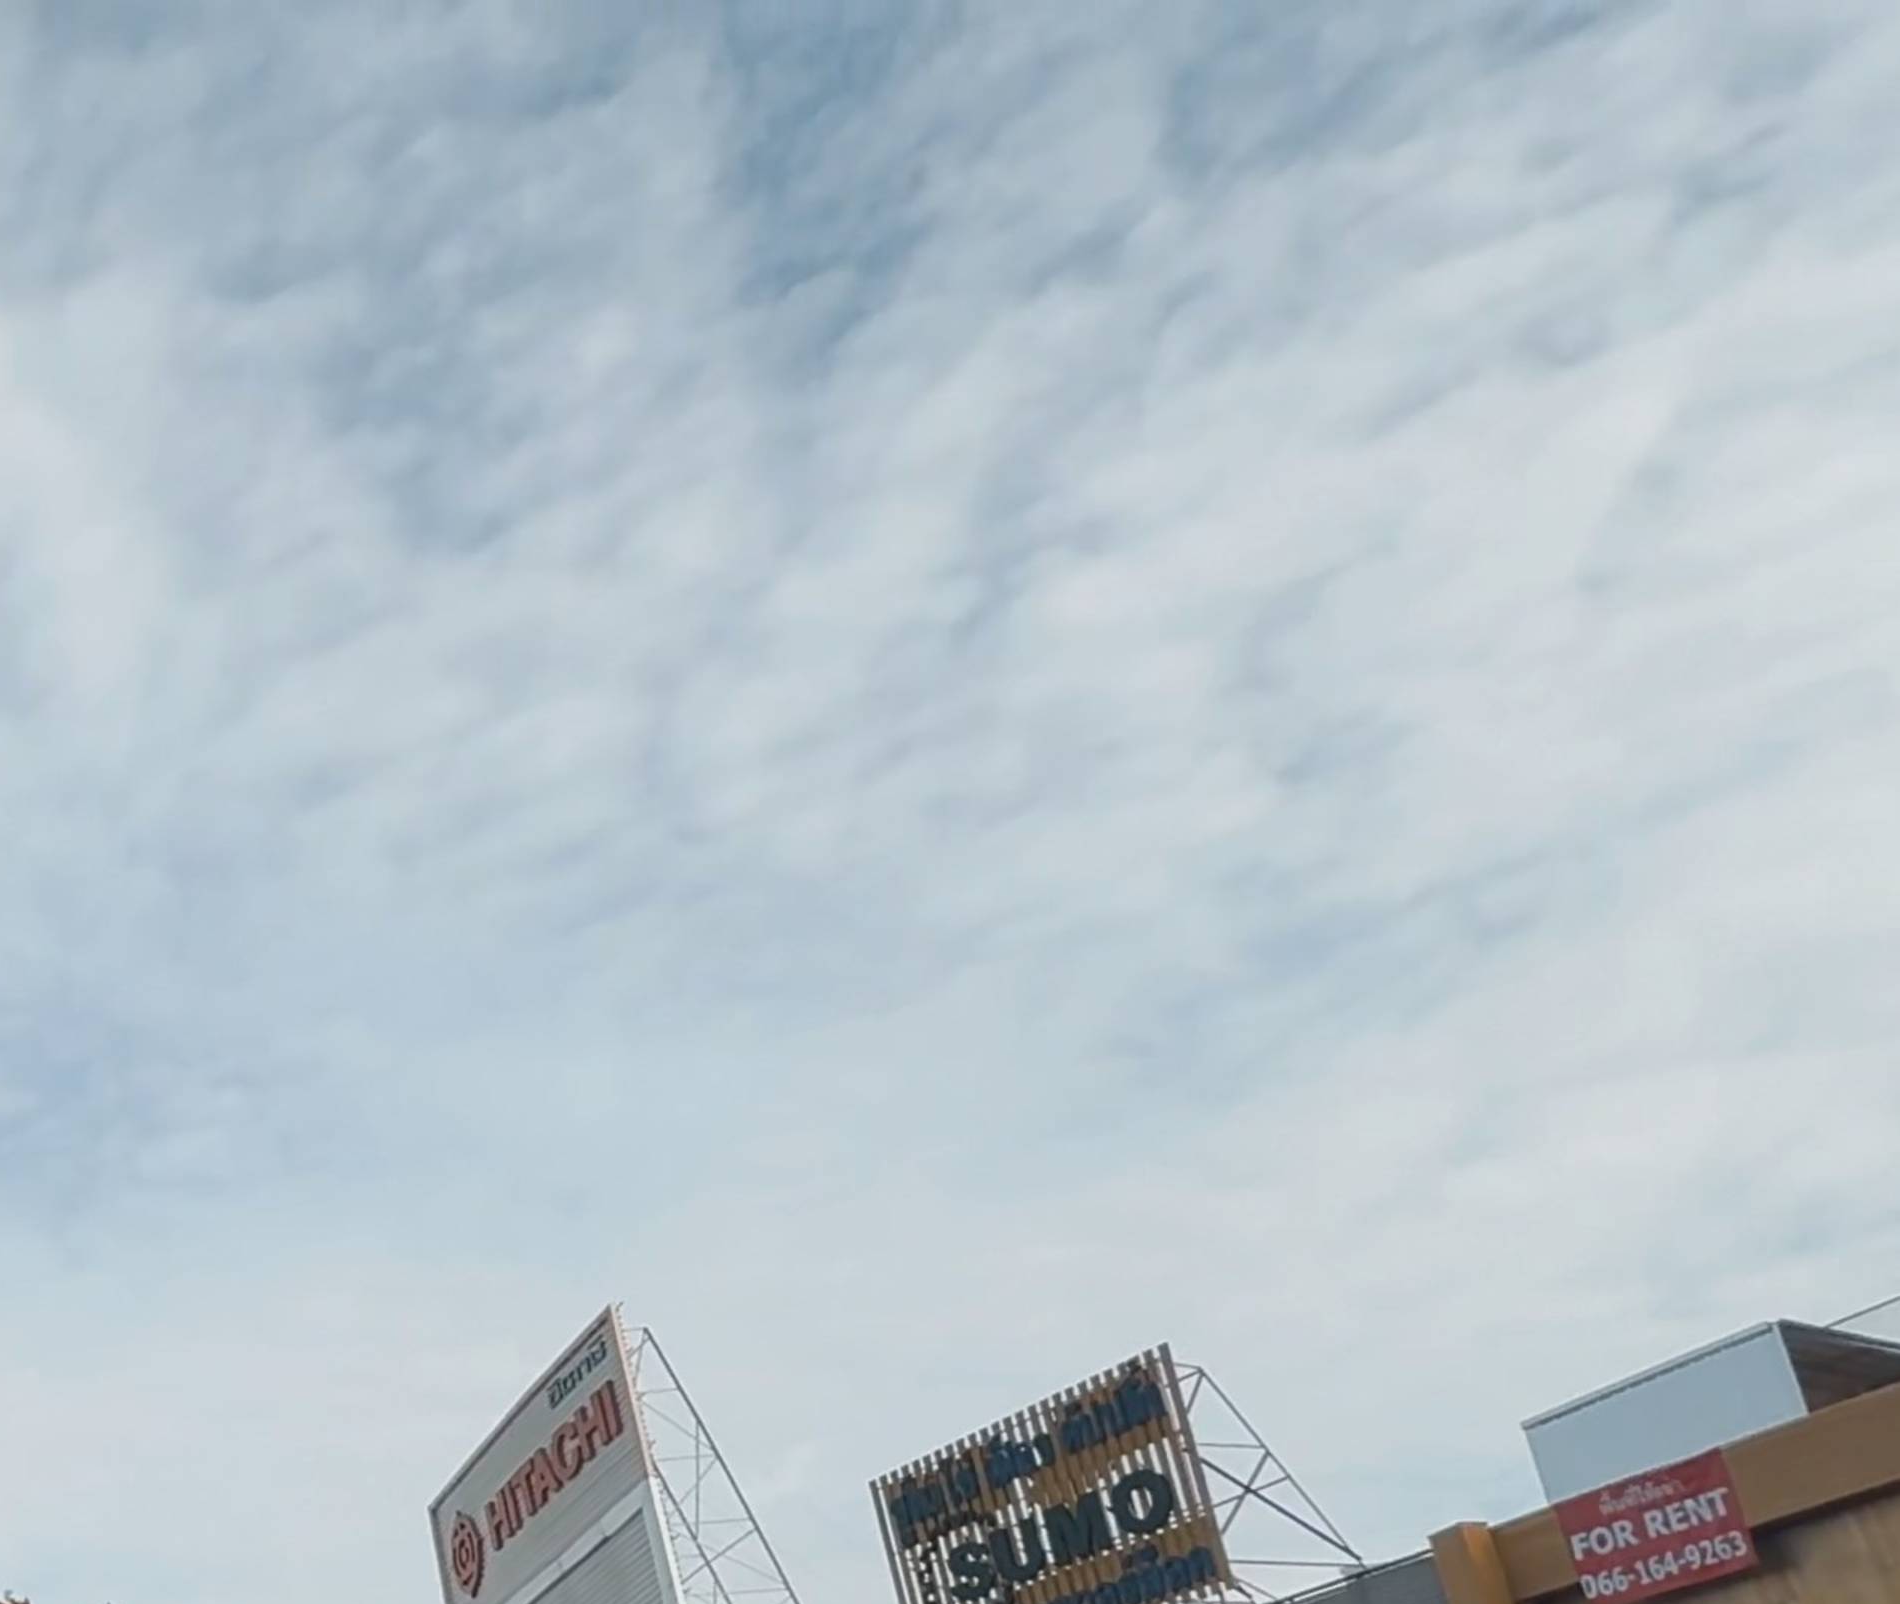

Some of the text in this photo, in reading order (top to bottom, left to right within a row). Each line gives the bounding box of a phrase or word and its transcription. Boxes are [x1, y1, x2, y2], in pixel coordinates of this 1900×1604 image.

[485, 1379, 624, 1551] HITACHI
[948, 1469, 1174, 1599] SUMO
[1570, 1486, 1729, 1561] FOR RENT
[1580, 1530, 1748, 1600] 066-164-9263
